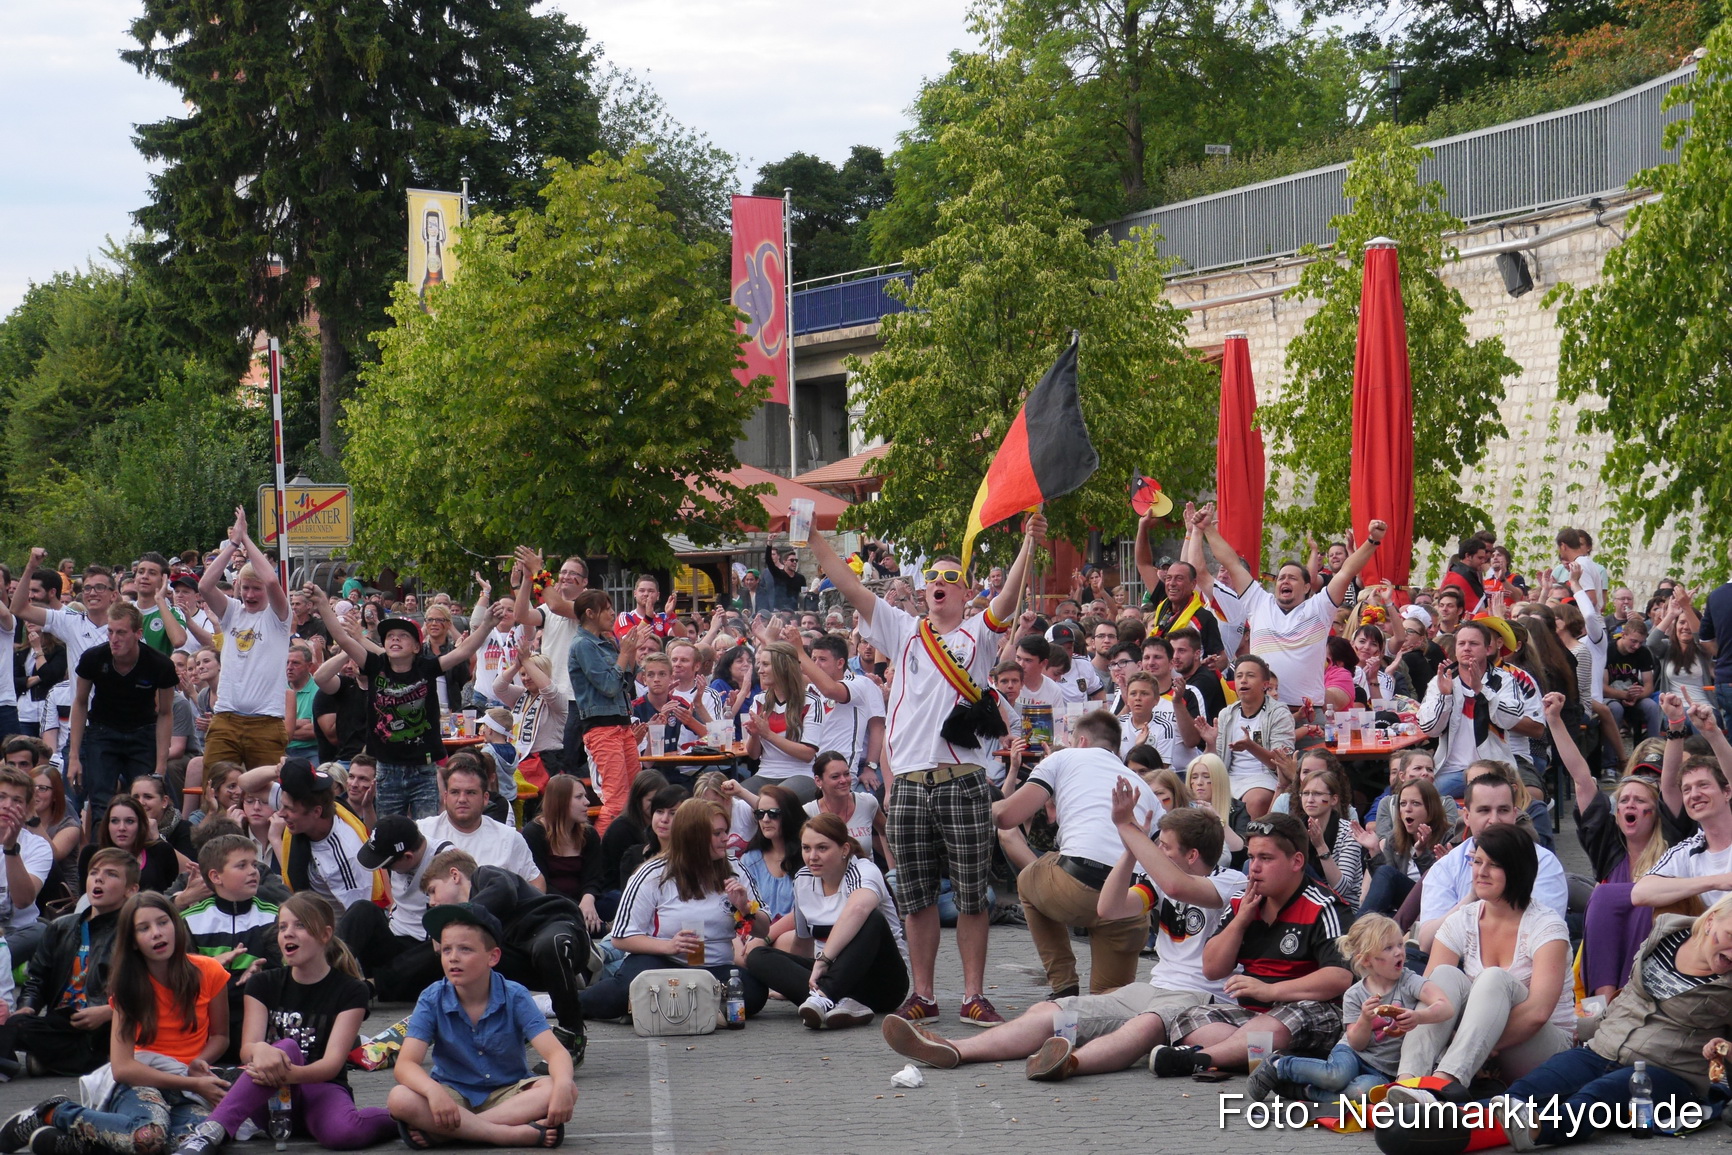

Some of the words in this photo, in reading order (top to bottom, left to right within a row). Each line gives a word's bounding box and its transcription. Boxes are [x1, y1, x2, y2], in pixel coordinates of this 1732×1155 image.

[271, 507, 342, 525] NUMARKTER
[1151, 710, 1178, 723] EISTE
[393, 841, 406, 853] 10
